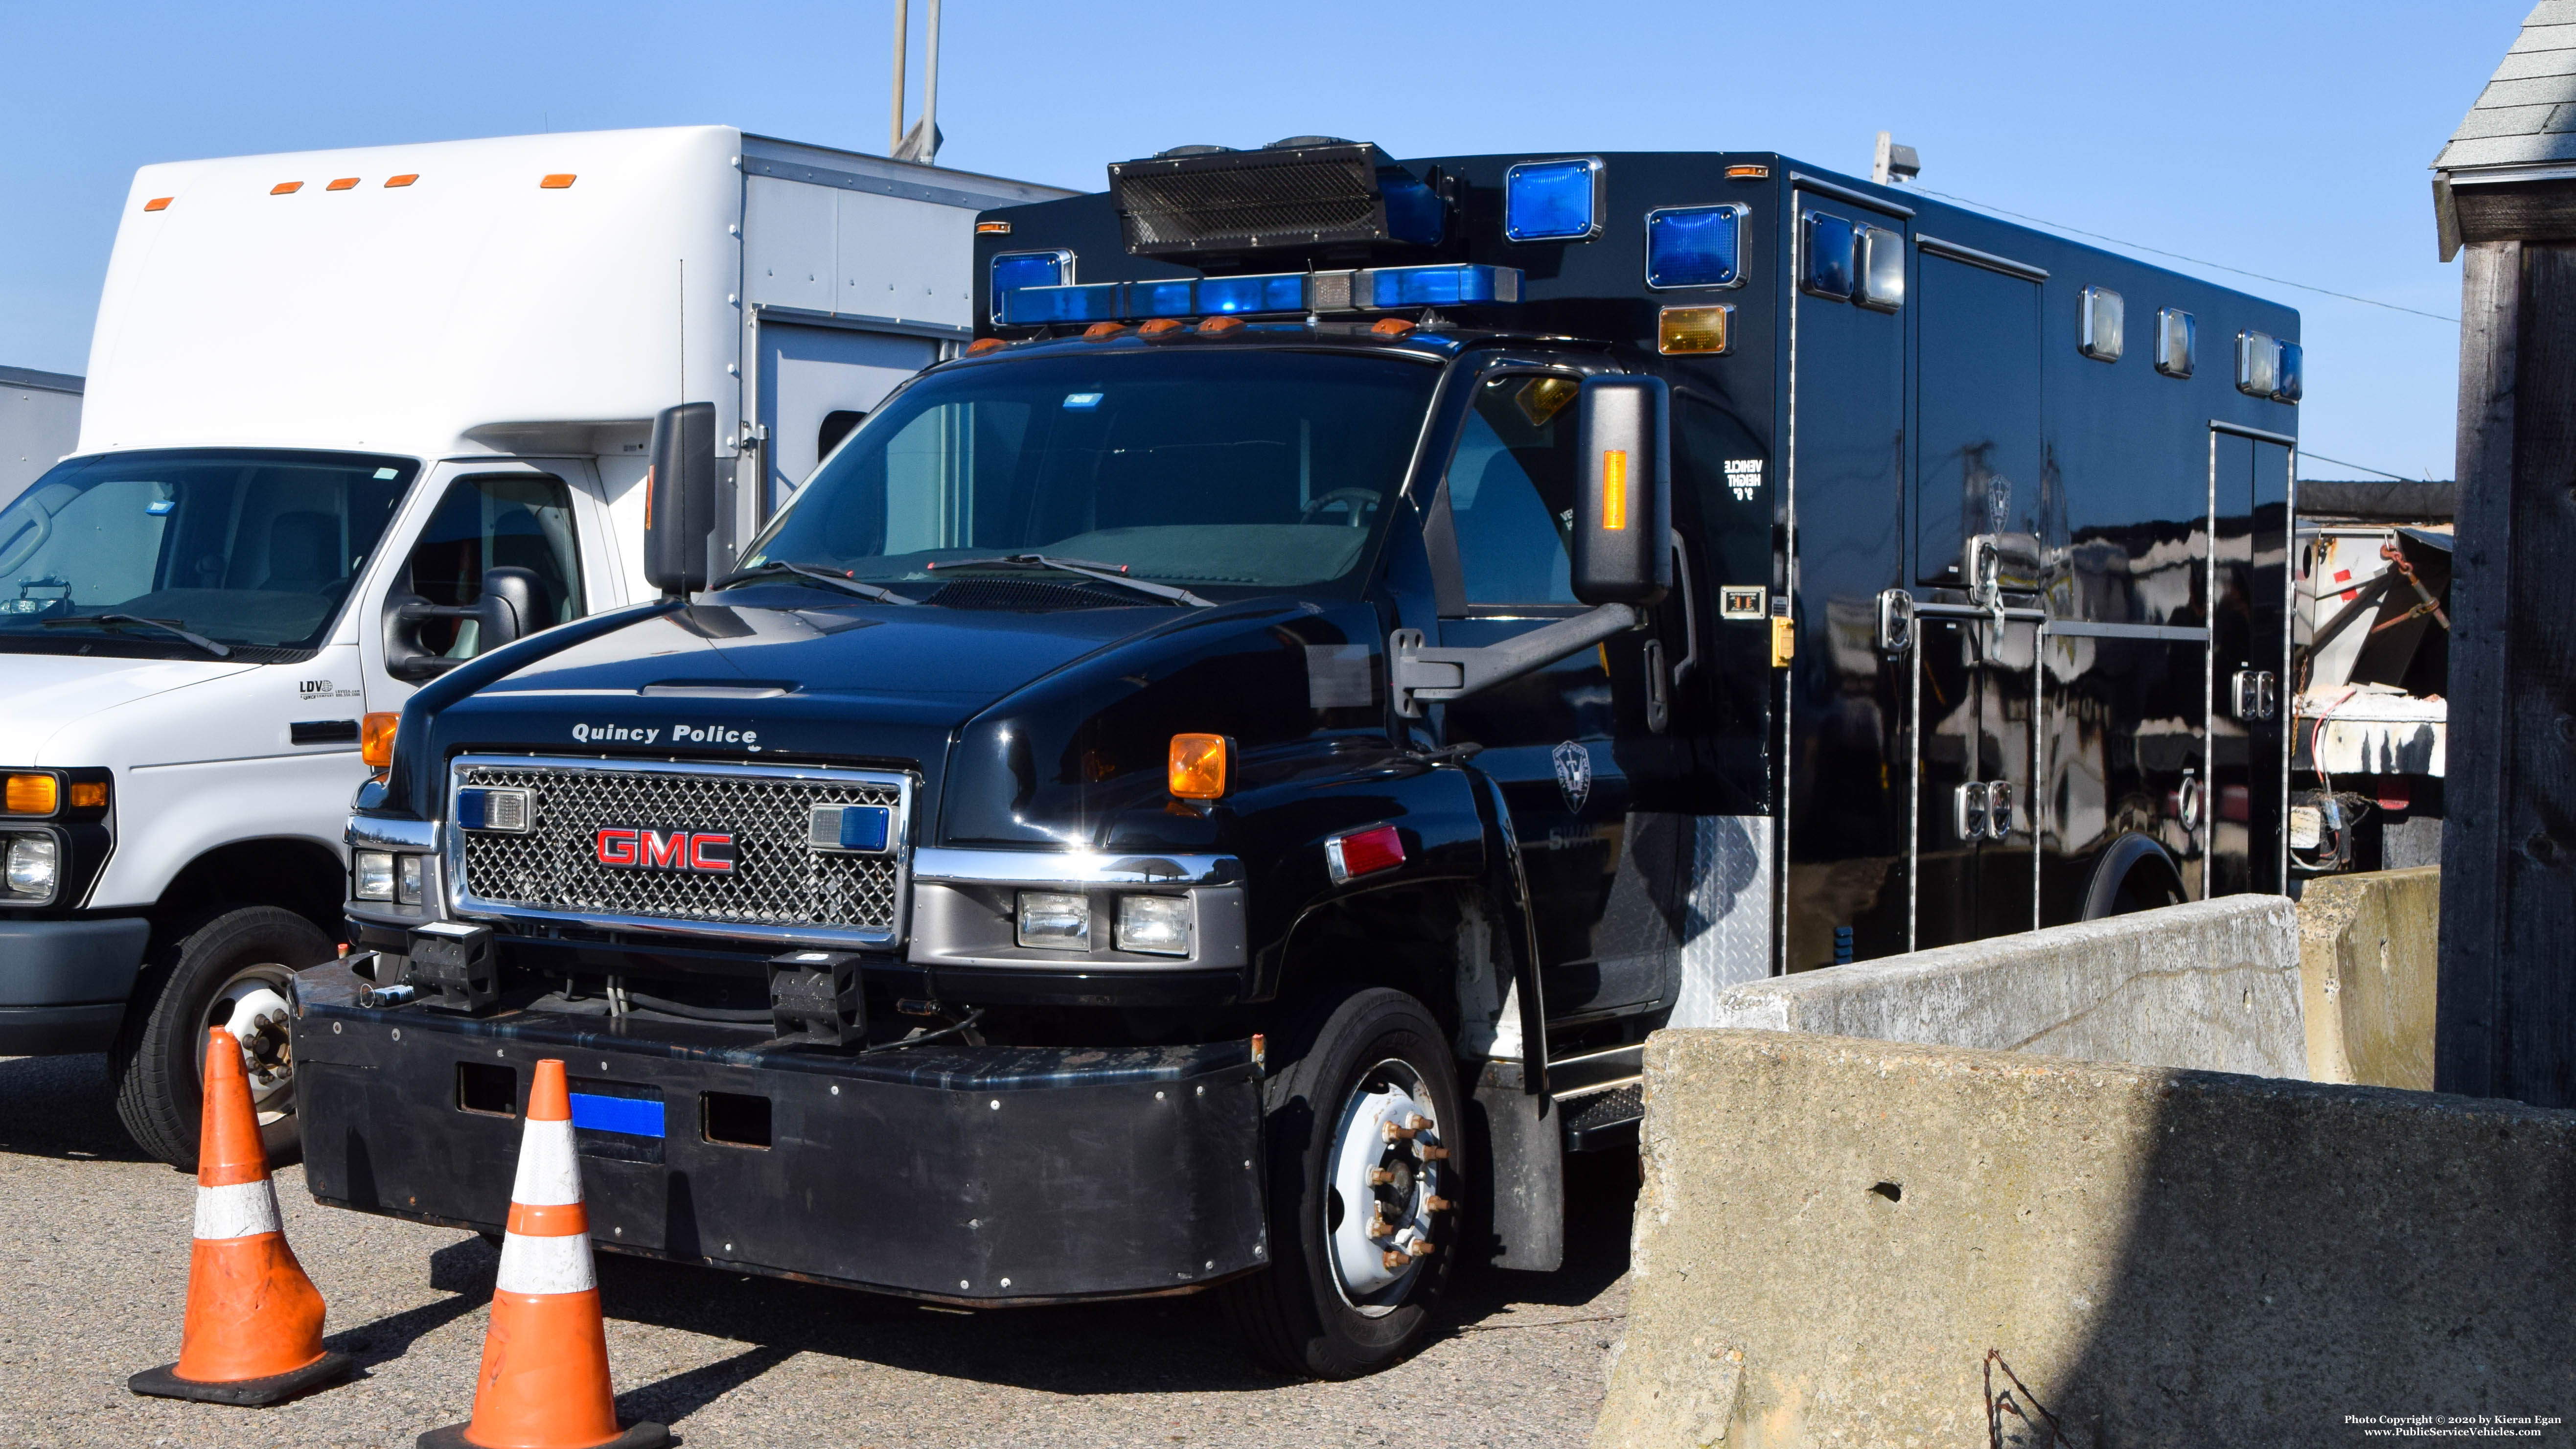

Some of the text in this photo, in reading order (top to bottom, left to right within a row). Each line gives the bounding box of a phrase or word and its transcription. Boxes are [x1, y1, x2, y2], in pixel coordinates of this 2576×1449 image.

[299, 680, 322, 692] LDV
[572, 723, 758, 744] Quincy Police
[598, 828, 734, 873] GMC
